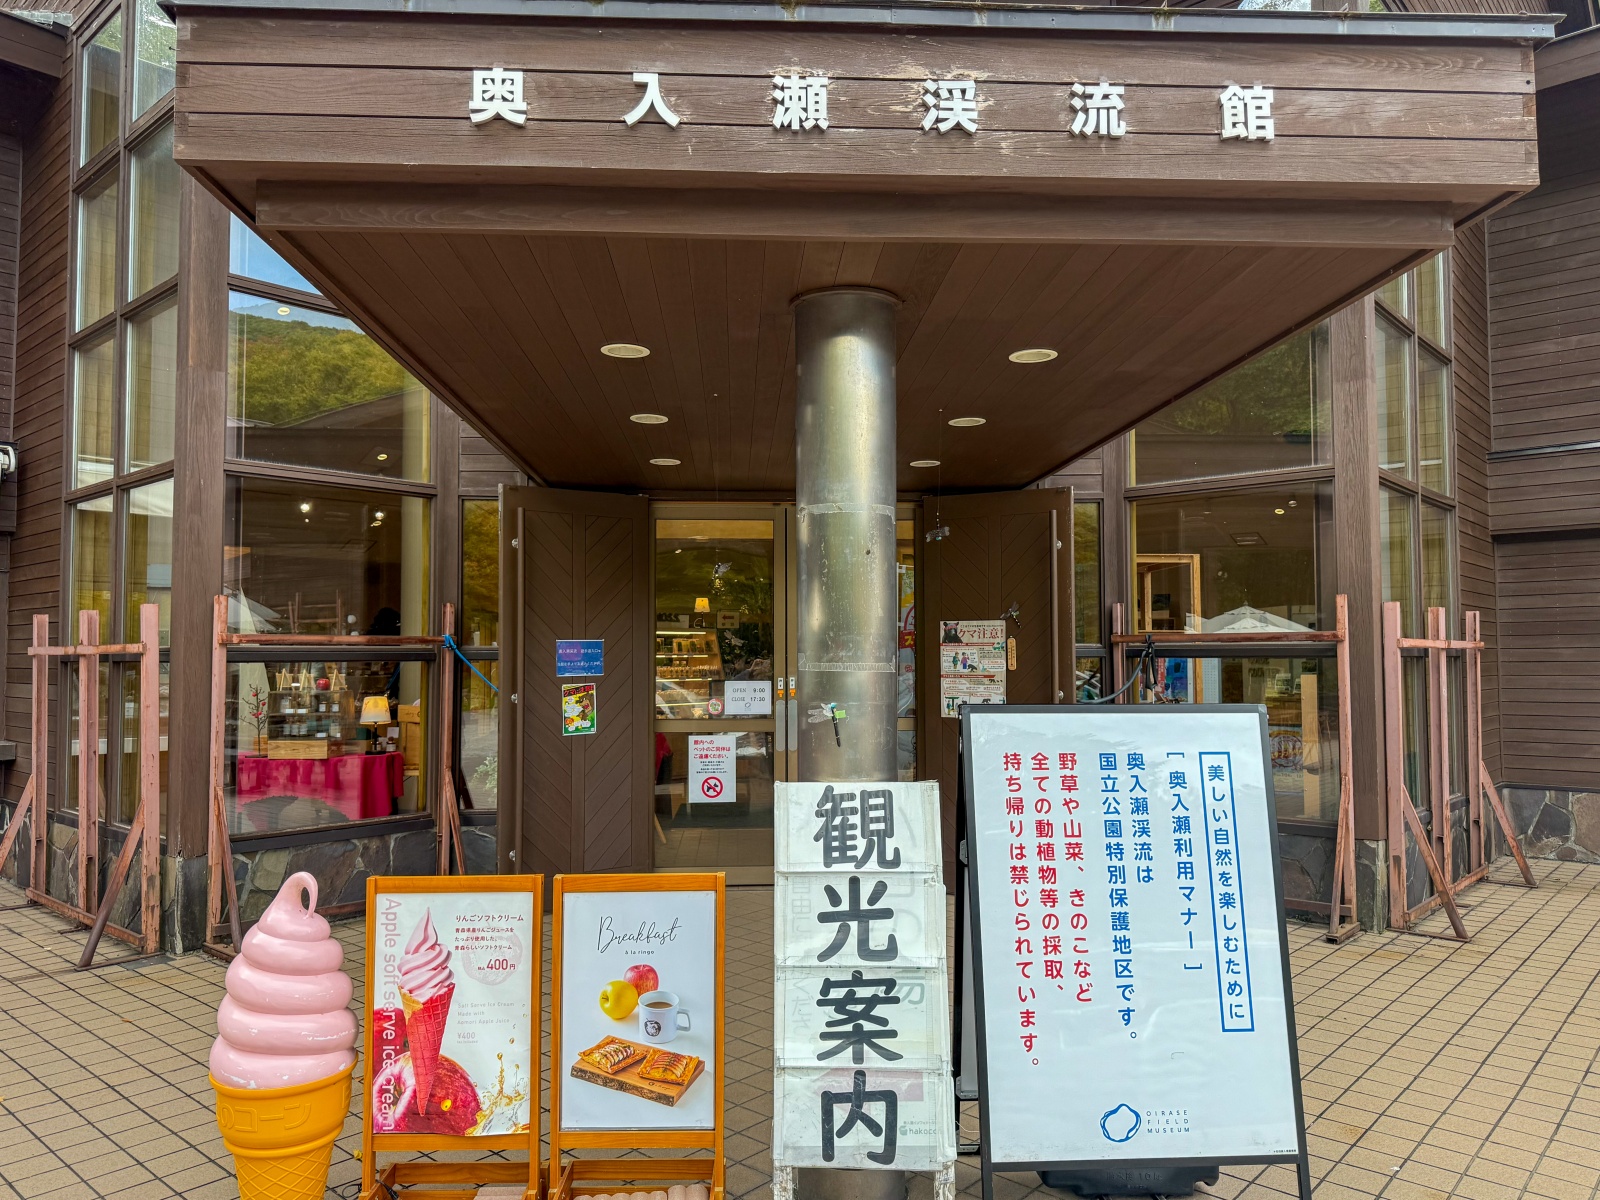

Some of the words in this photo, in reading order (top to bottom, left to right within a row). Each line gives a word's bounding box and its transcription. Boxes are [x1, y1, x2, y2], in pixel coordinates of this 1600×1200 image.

[469, 67, 1276, 142] 奥入瀬渓流館
[1126, 752, 1154, 884] 奥入瀬渓流は
[1030, 752, 1064, 991] 全ての動植物等の採取、
[1058, 752, 1093, 1003] 野草や山菜、きのこなど
[1099, 752, 1138, 1039] 国立公園特別保護地区です。
[1207, 764, 1246, 1020] 美しい自然を楽しむために
[381, 898, 401, 947] Apple
[456, 914, 525, 922] りんごソフトクリーム
[1003, 752, 1039, 1066] 持ち帰りは禁じられています。
[597, 916, 683, 954] Breakfast
[384, 955, 400, 986] soft
[813, 785, 904, 1172] 観光案内
[382, 992, 396, 1040] serve
[457, 1031, 476, 1040] ¥400
[382, 1045, 400, 1069] ice
[382, 1077, 396, 1131] cream
[1145, 1109, 1188, 1117] OIRASE
[1147, 1118, 1189, 1126] FIELD
